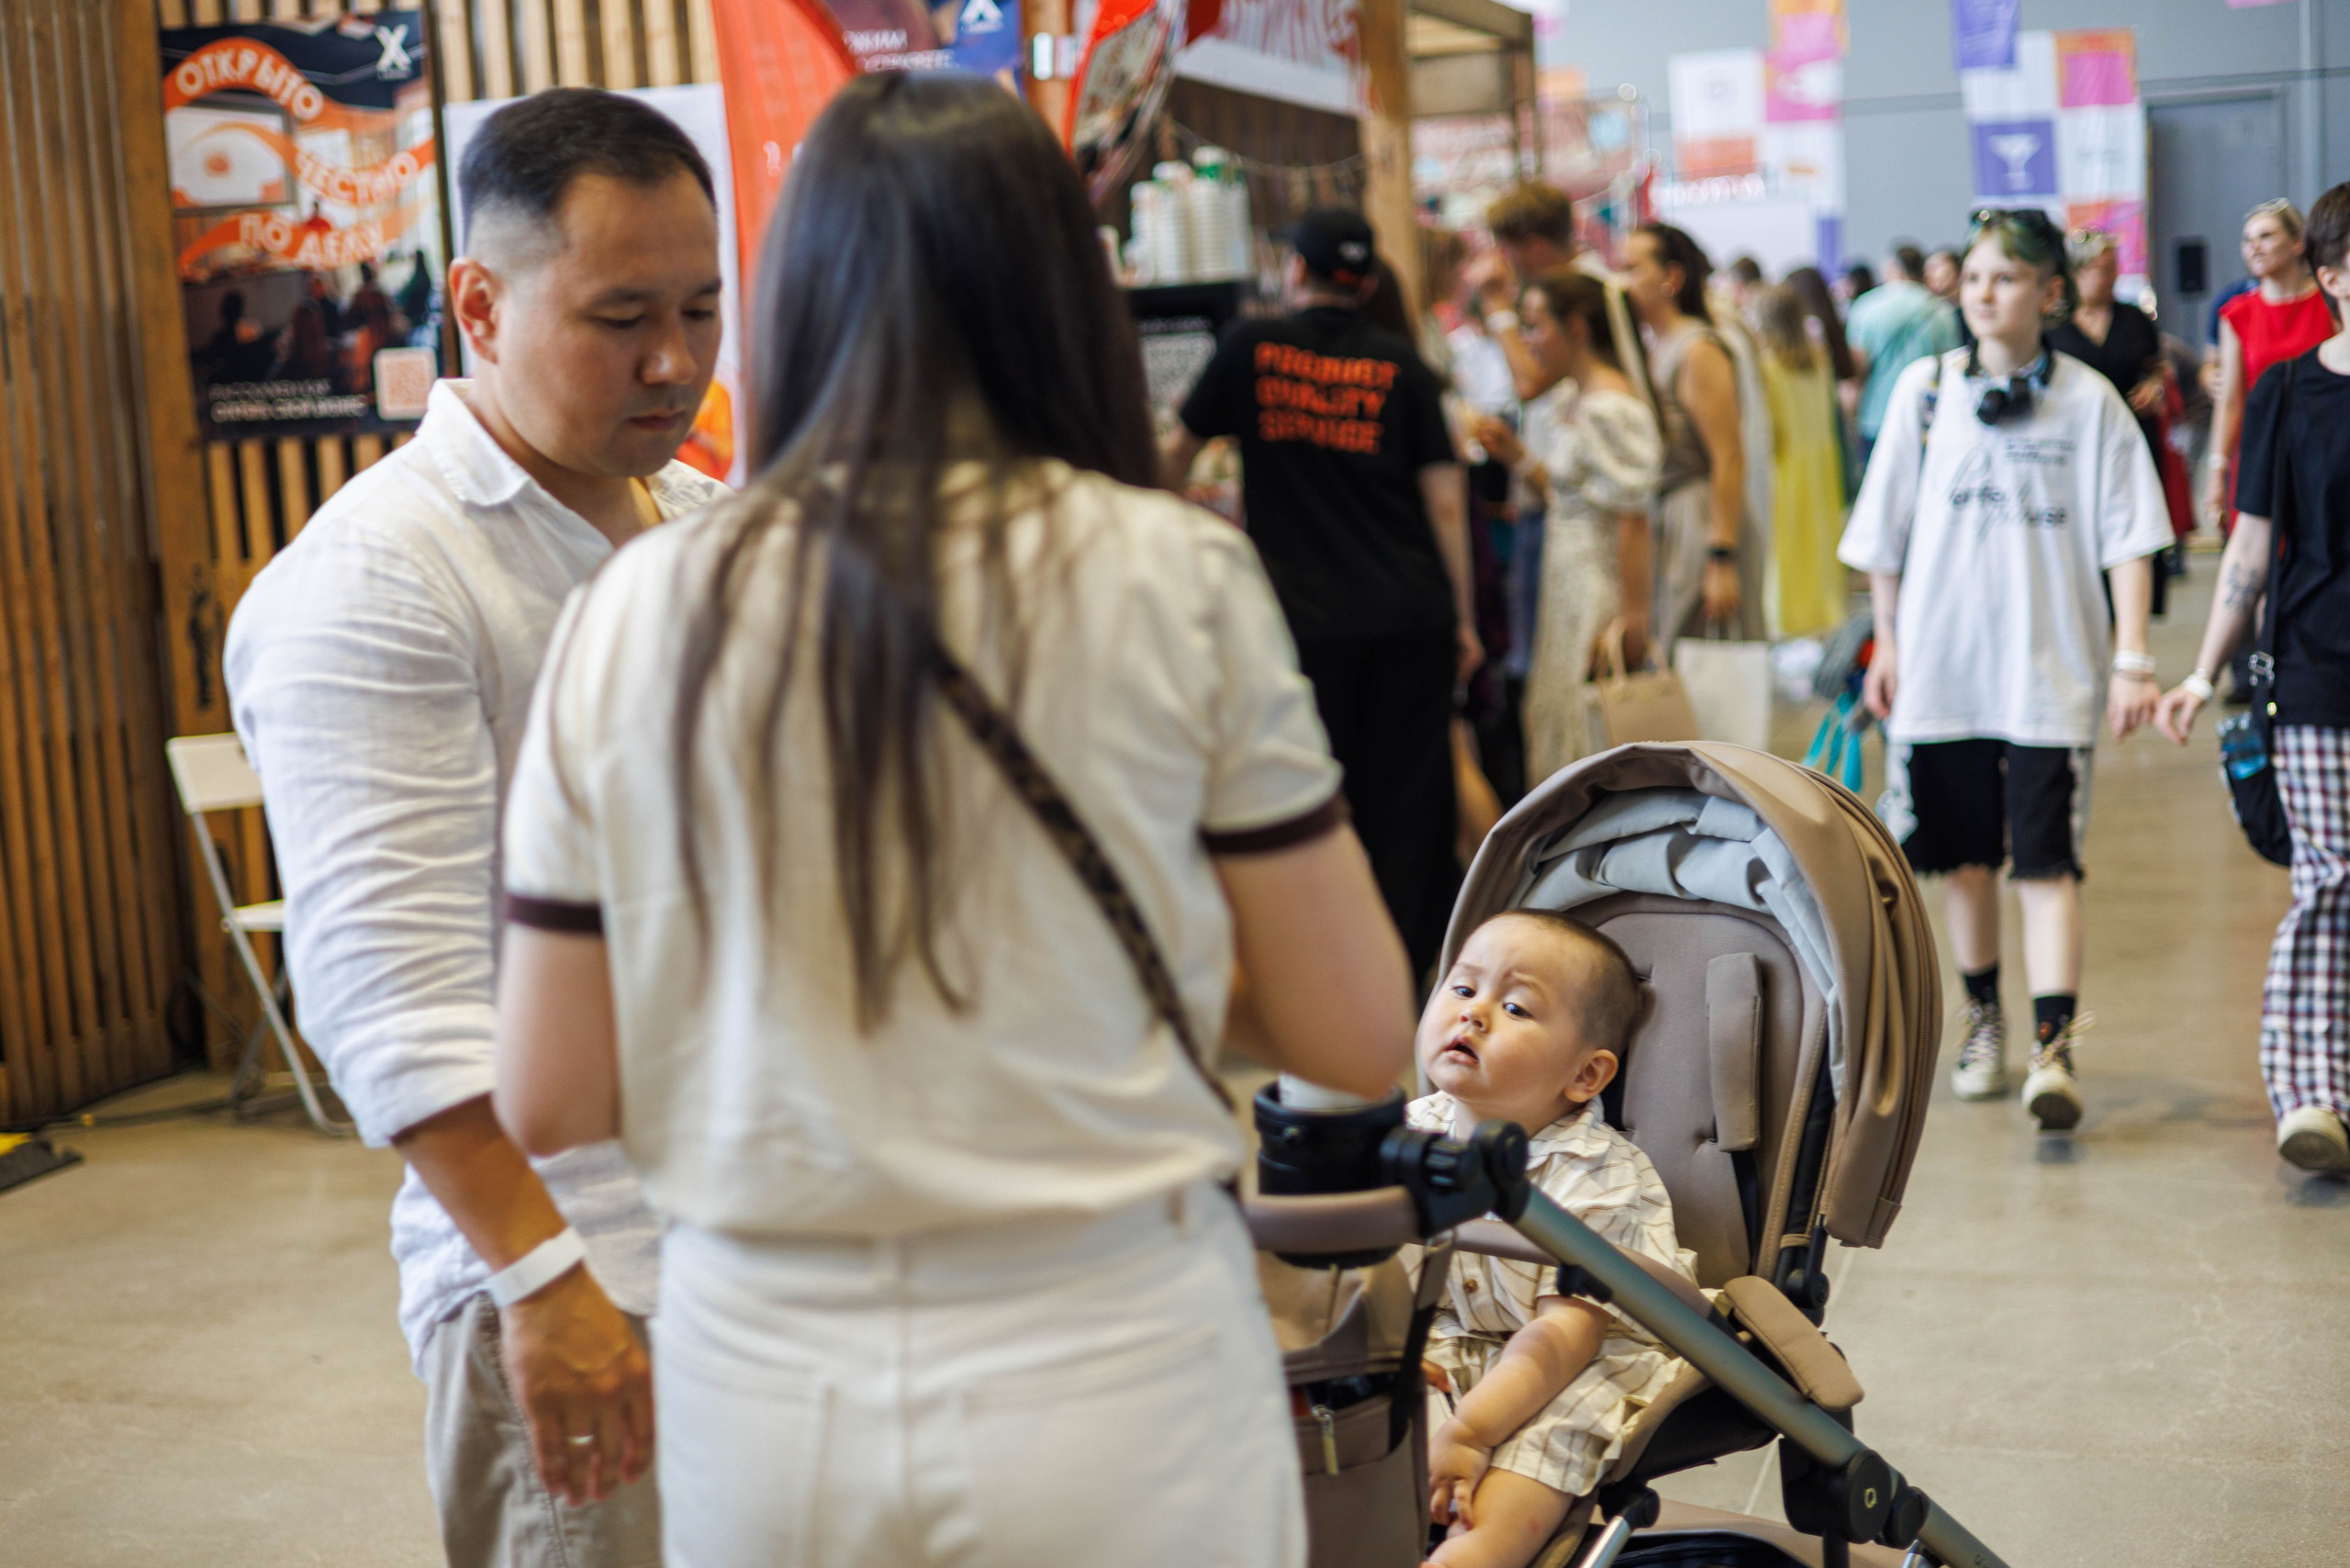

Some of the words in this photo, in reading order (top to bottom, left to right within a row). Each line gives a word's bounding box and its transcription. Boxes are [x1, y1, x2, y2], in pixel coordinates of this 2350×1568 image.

[175, 48, 324, 121] ОТКРЫТО
[295, 151, 420, 207] ЧЕСТНО
[240, 212, 293, 254] ПО
[295, 219, 383, 265] ДЕЛУ
[1254, 342, 1400, 391] PRODUCT
[1255, 375, 1386, 420] QUALITY
[1258, 409, 1383, 454] SERVICE
